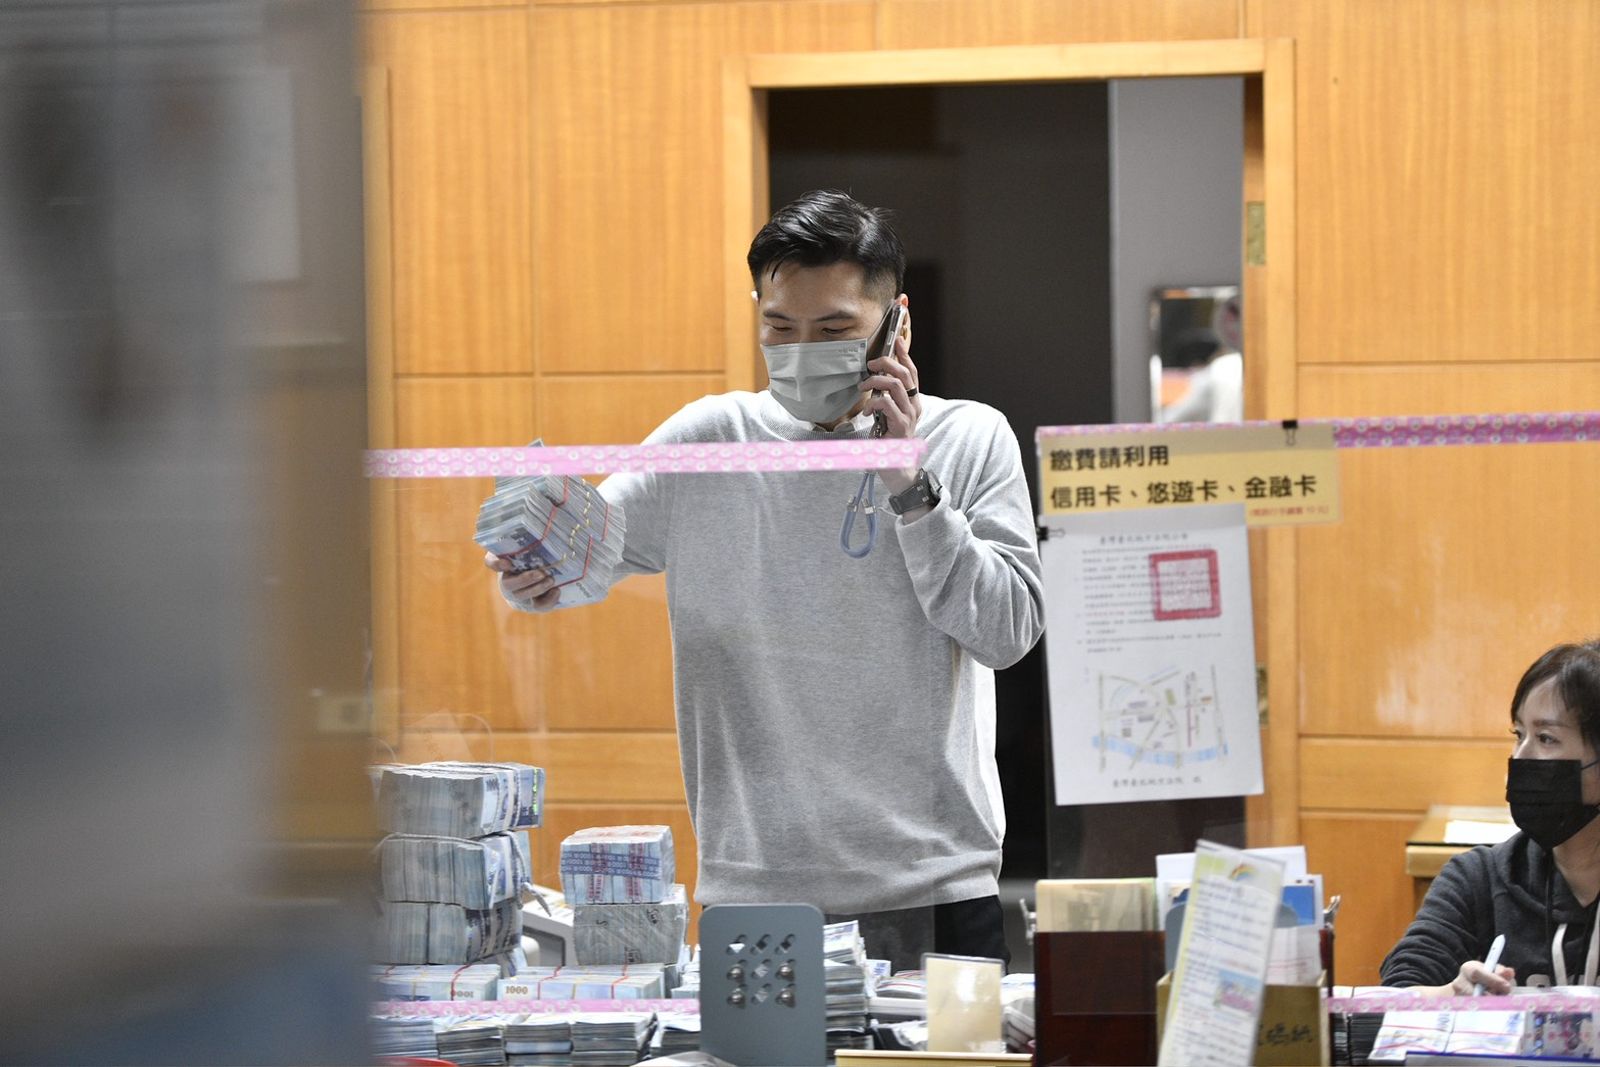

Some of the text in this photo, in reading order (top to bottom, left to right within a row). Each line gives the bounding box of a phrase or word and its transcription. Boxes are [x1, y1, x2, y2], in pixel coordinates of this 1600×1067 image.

[1050, 445, 1169, 471] 繳費請利用
[1051, 474, 1317, 508] 信用卡、悠遊卡、金融卡
[505, 986, 529, 995] 1000
